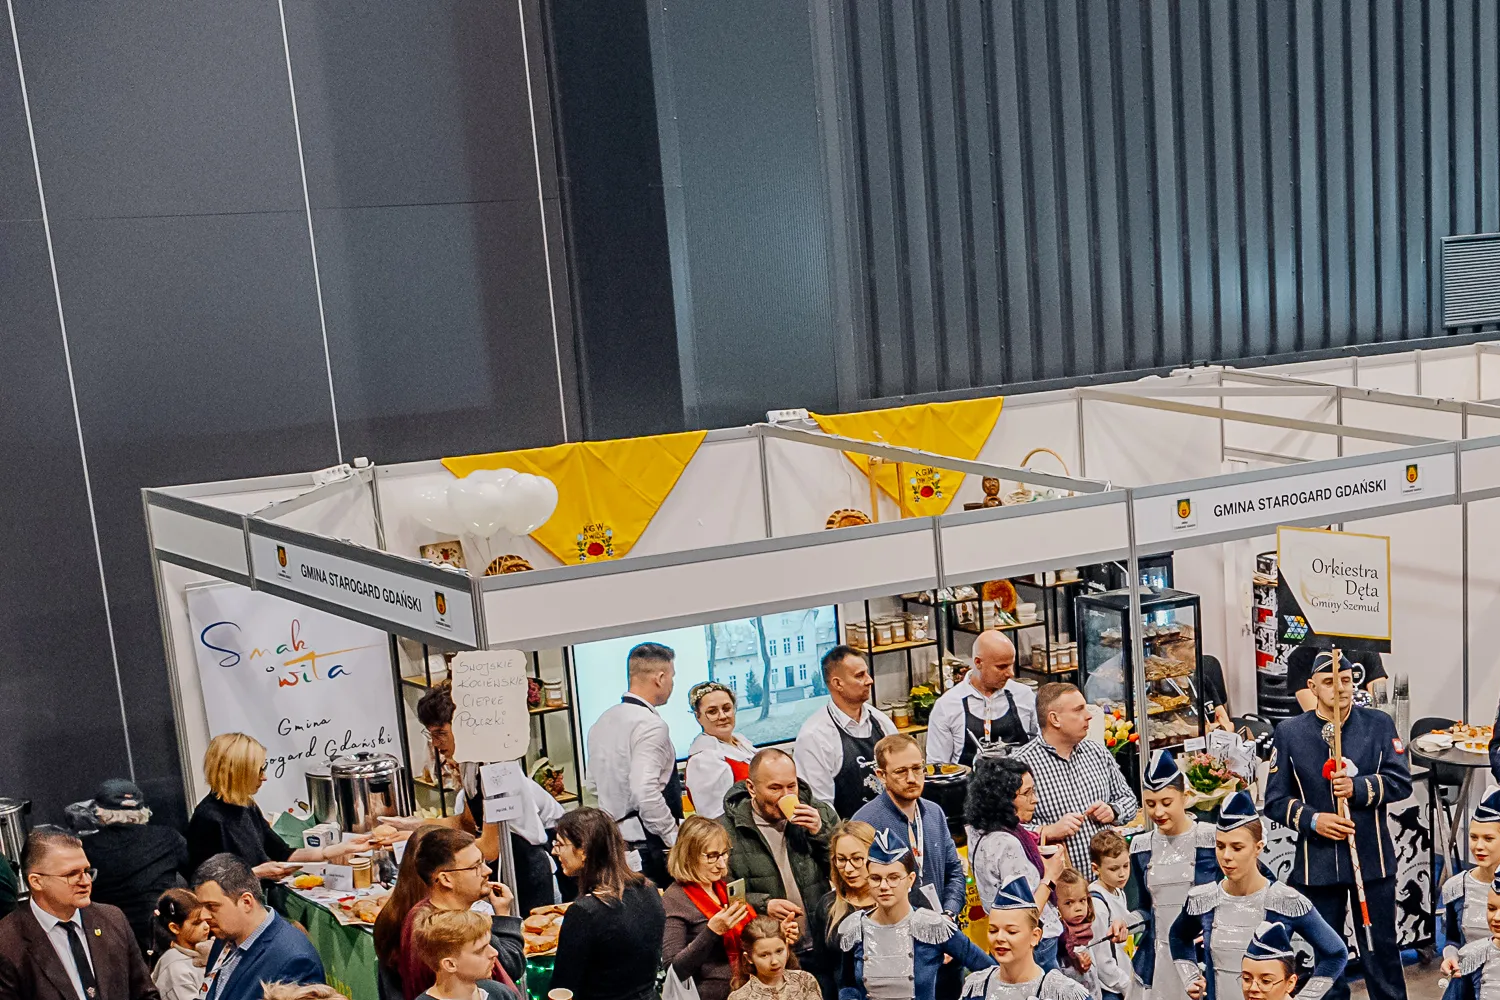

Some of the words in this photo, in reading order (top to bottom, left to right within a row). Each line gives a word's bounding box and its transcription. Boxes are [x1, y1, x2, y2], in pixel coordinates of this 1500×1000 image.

[1213, 500, 1255, 518] GMINA
[1258, 487, 1332, 511] STAROGARD
[1335, 479, 1387, 498] GDAŃSKI
[583, 523, 604, 534] KGW
[1311, 557, 1379, 580] Orkiestra
[300, 564, 329, 586] GMINA
[329, 573, 380, 600] STAROGARD
[382, 589, 422, 612] GDAŃSKI
[1345, 579, 1379, 601] Dęta
[1311, 597, 1342, 613] Gminy
[1342, 600, 1380, 613] Szemud
[200, 619, 309, 668] Smak
[277, 717, 332, 736] Gmina
[264, 736, 317, 778] ogard
[324, 726, 393, 758] Gdański
